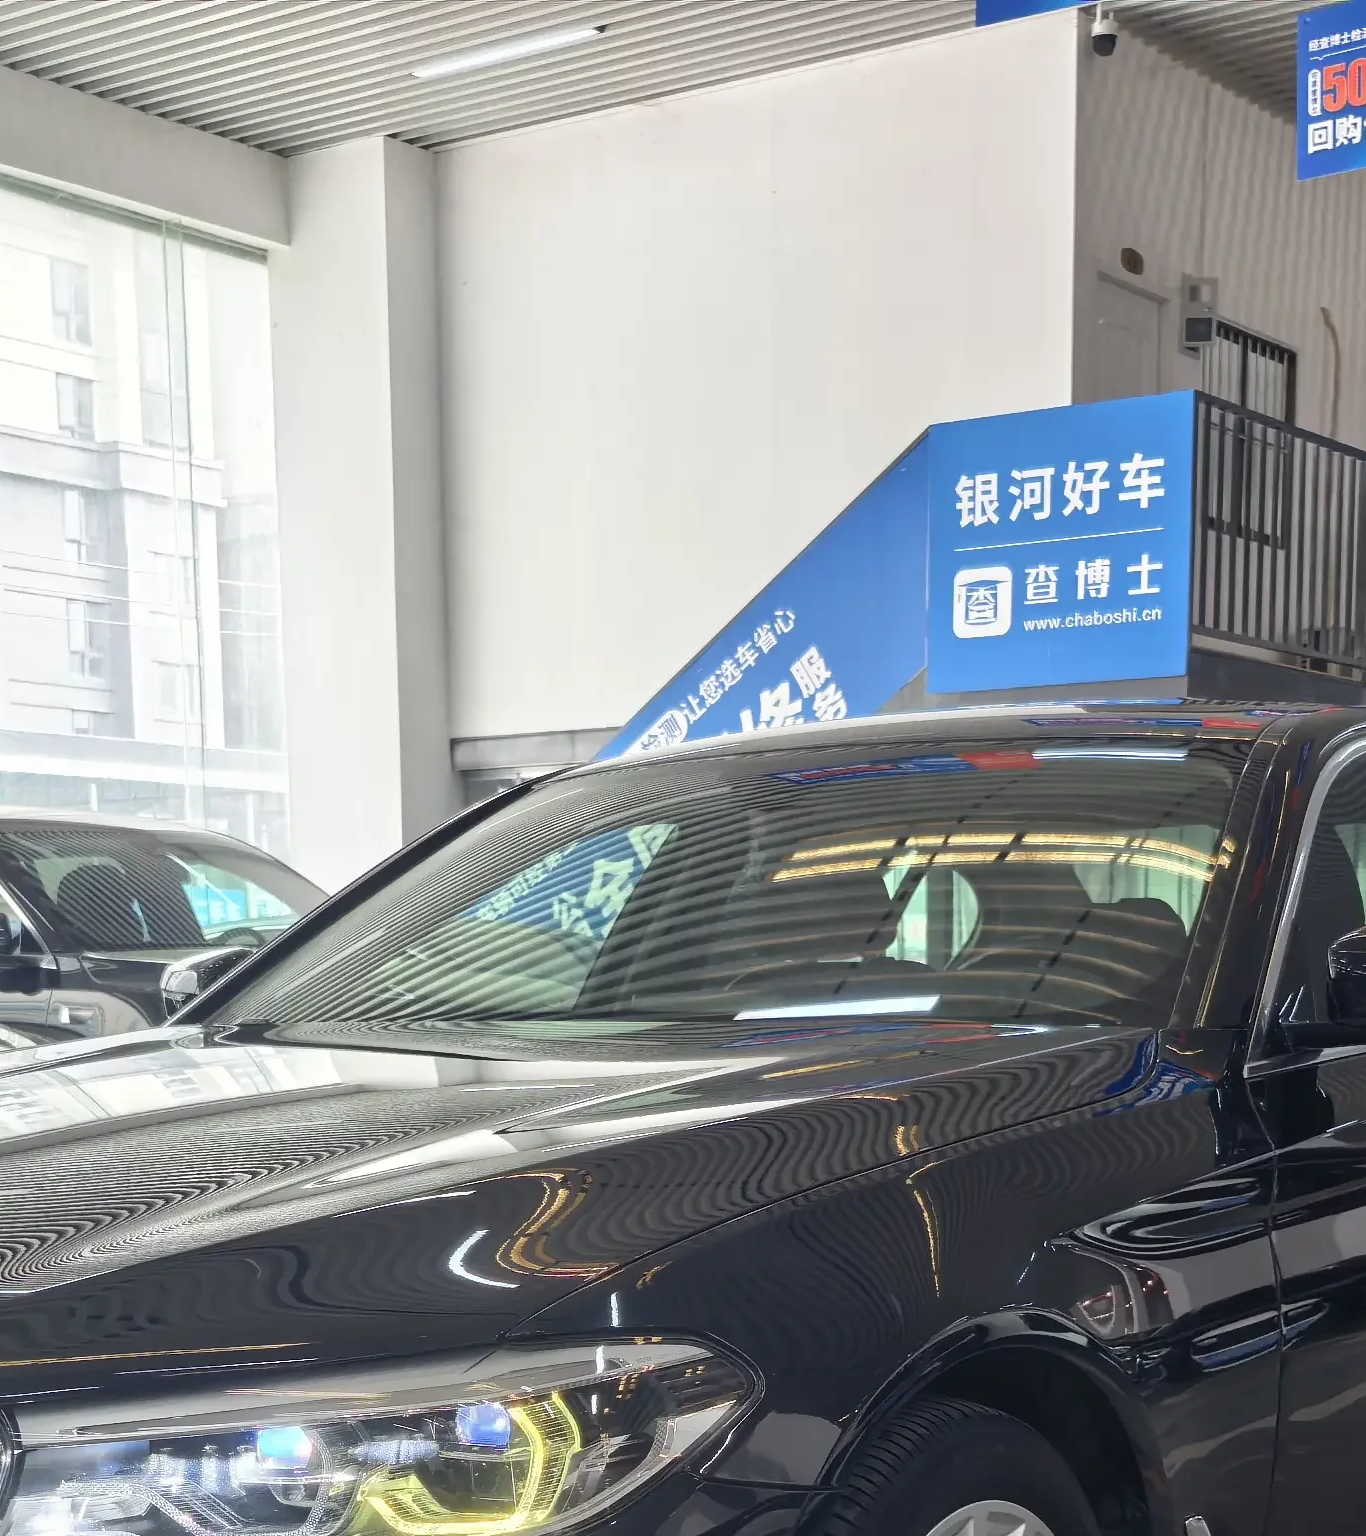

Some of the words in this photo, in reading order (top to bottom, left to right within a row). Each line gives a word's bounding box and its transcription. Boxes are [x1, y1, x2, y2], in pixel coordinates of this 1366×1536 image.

[954, 452, 1166, 528] 银河好车
[1023, 552, 1164, 605] 查博士
[1023, 607, 1163, 632] www.chaboshi.cn
